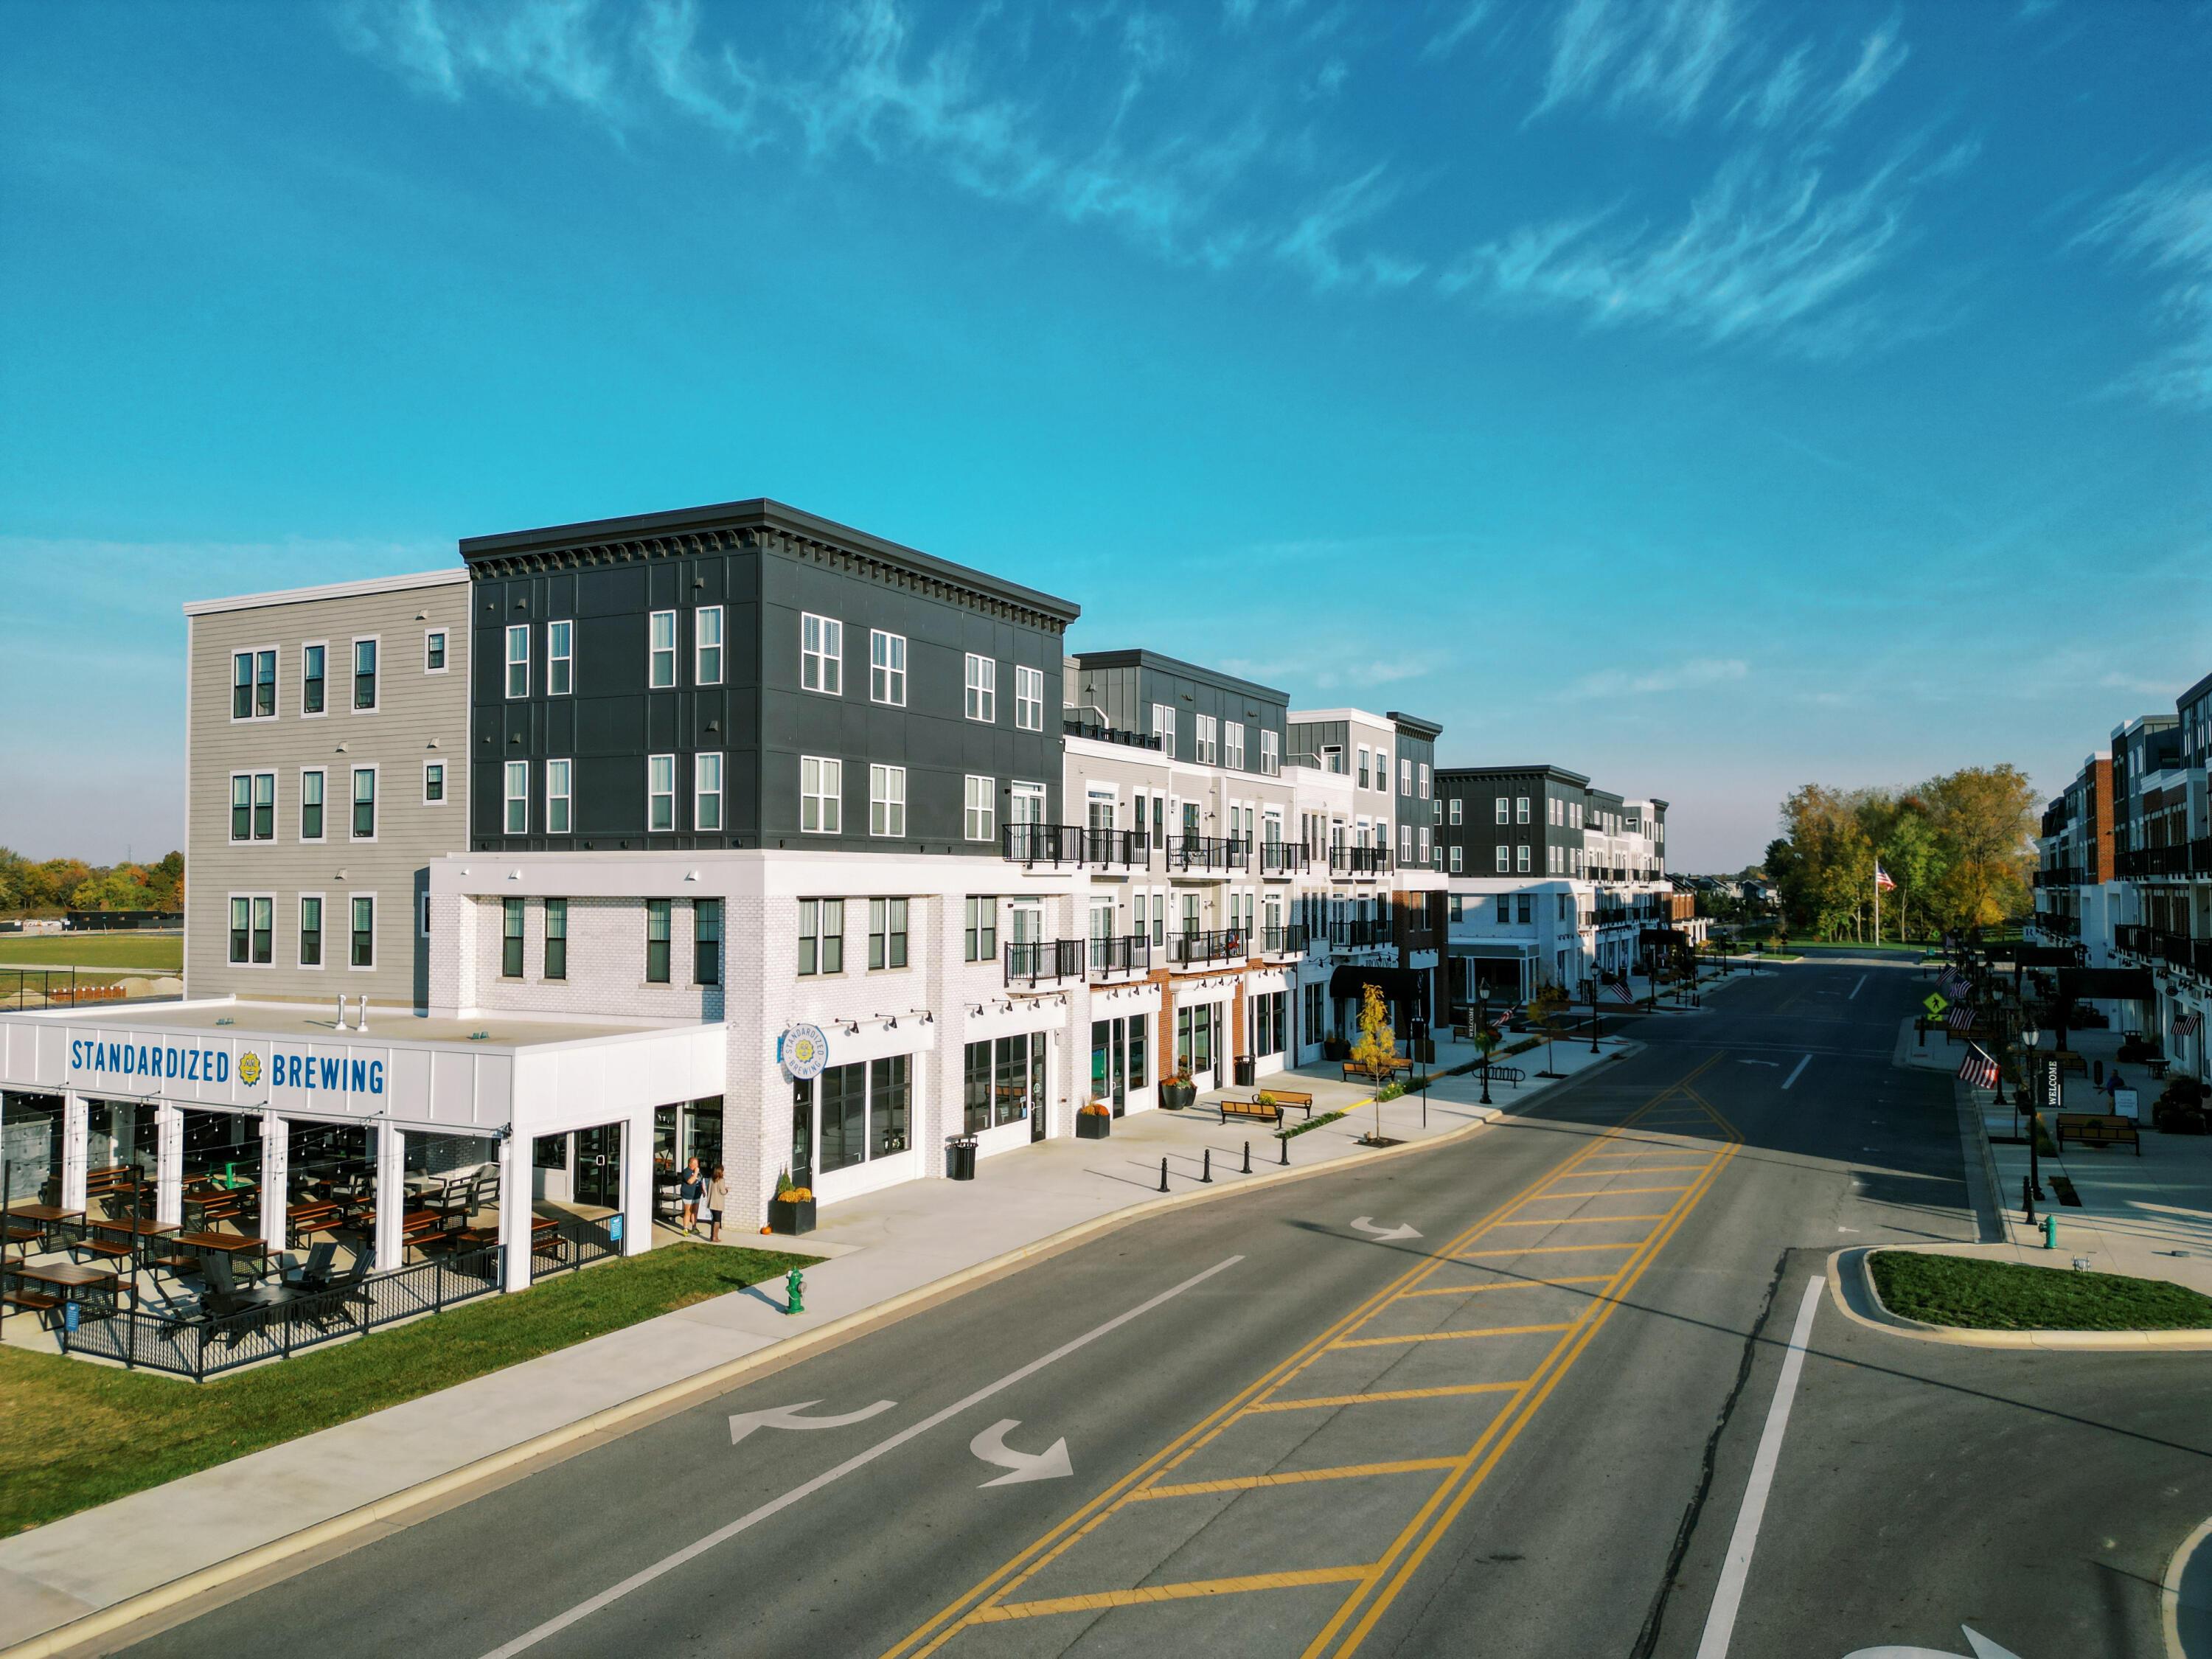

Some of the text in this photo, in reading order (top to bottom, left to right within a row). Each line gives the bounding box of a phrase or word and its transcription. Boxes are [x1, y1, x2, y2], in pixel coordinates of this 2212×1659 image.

[786, 1028, 824, 1055] STANDARDIZED
[72, 1040, 383, 1094] STANDARDIZED BREWING
[789, 1060, 821, 1075] BREWING
[2048, 1061, 2057, 1105] WELCOME
[796, 1093, 801, 1101] A
